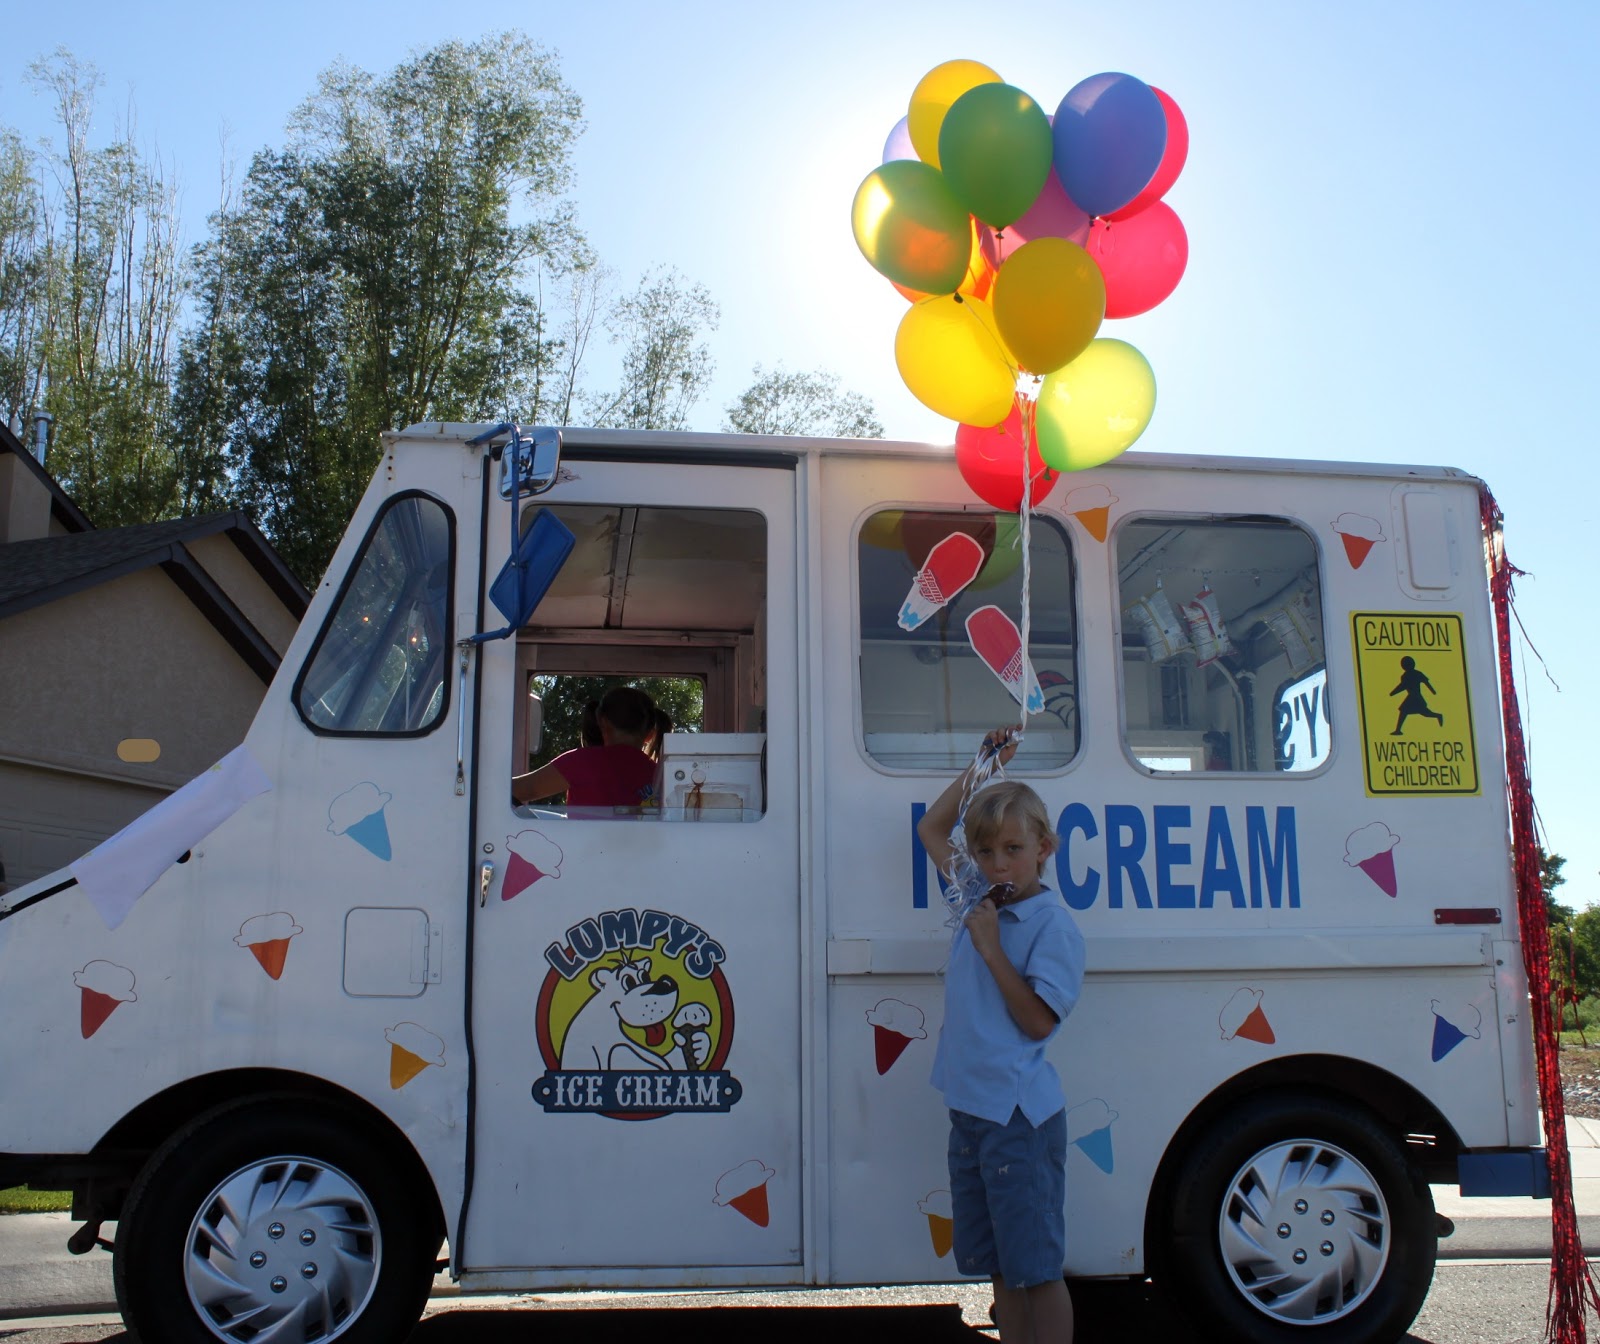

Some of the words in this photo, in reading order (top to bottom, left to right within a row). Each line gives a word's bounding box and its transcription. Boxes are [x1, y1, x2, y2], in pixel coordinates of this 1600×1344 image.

[1364, 620, 1450, 646] CAUTION
[1374, 741, 1429, 763] WATCH
[1433, 742, 1466, 763] FOR
[1383, 765, 1461, 786] CHILDREN
[1055, 802, 1302, 910] CREAM
[545, 909, 726, 980] LUMPY'S
[554, 1076, 602, 1106] ICE
[615, 1076, 721, 1106] CREAM
